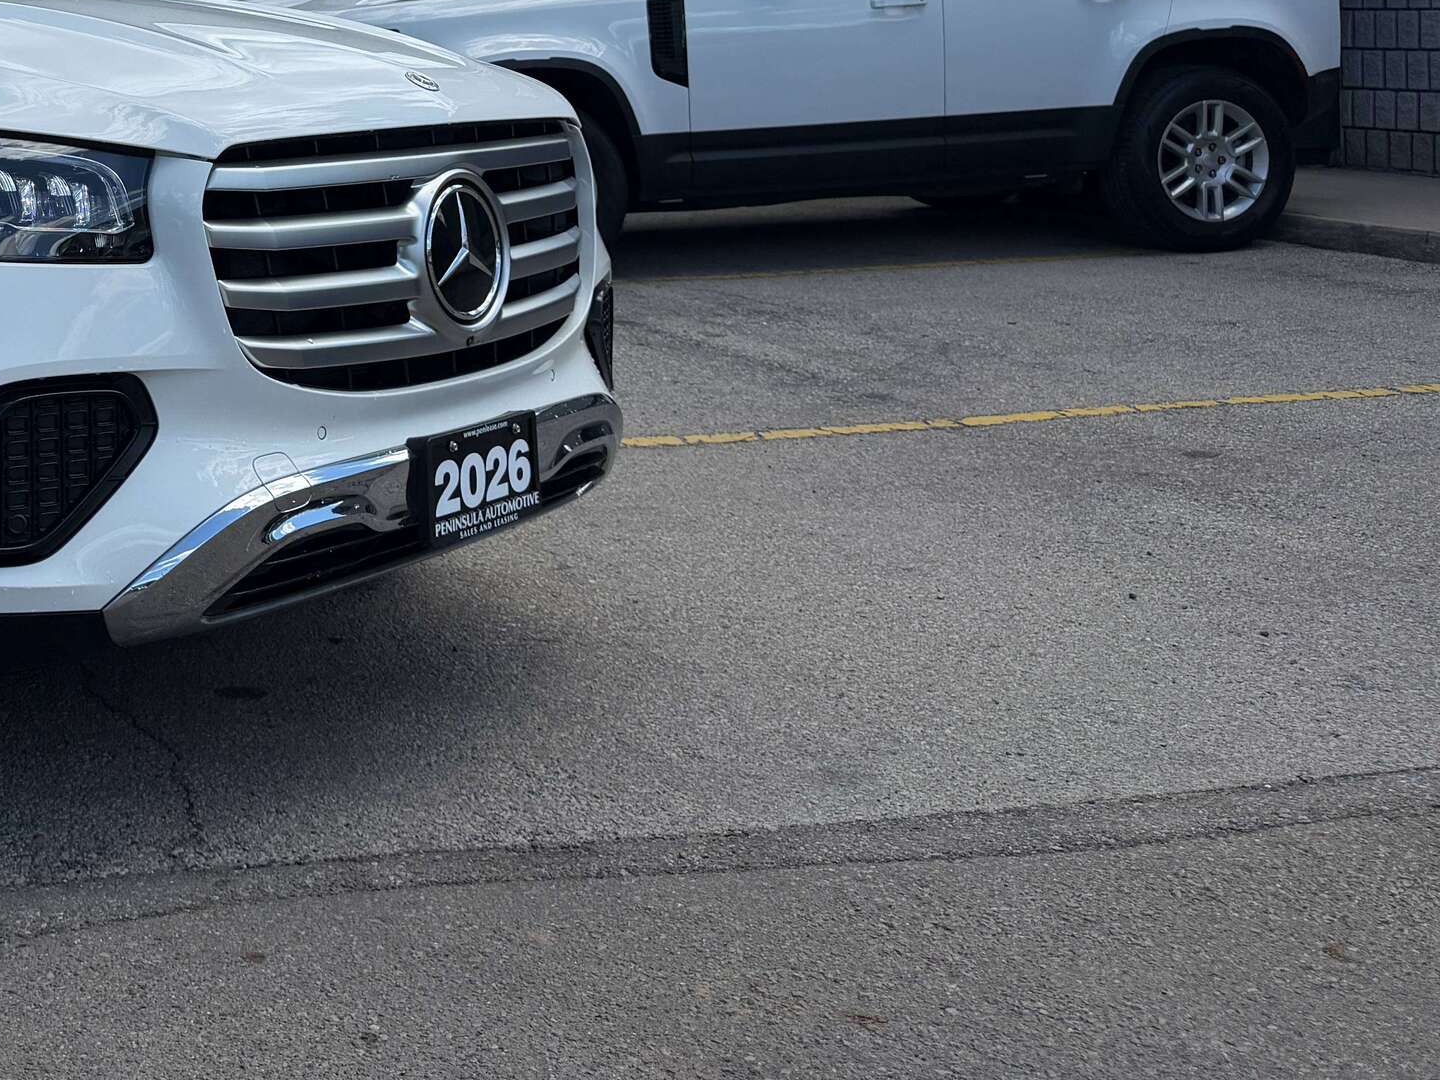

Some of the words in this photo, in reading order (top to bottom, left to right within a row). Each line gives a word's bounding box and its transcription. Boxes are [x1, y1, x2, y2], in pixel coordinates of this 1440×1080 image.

[434, 438, 532, 518] 2026
[435, 510, 484, 537] PENINSULA
[485, 491, 540, 521] AUTOMOTIVE
[460, 526, 478, 539] SALES
[479, 522, 492, 533] AND
[494, 513, 519, 528] LEASING
